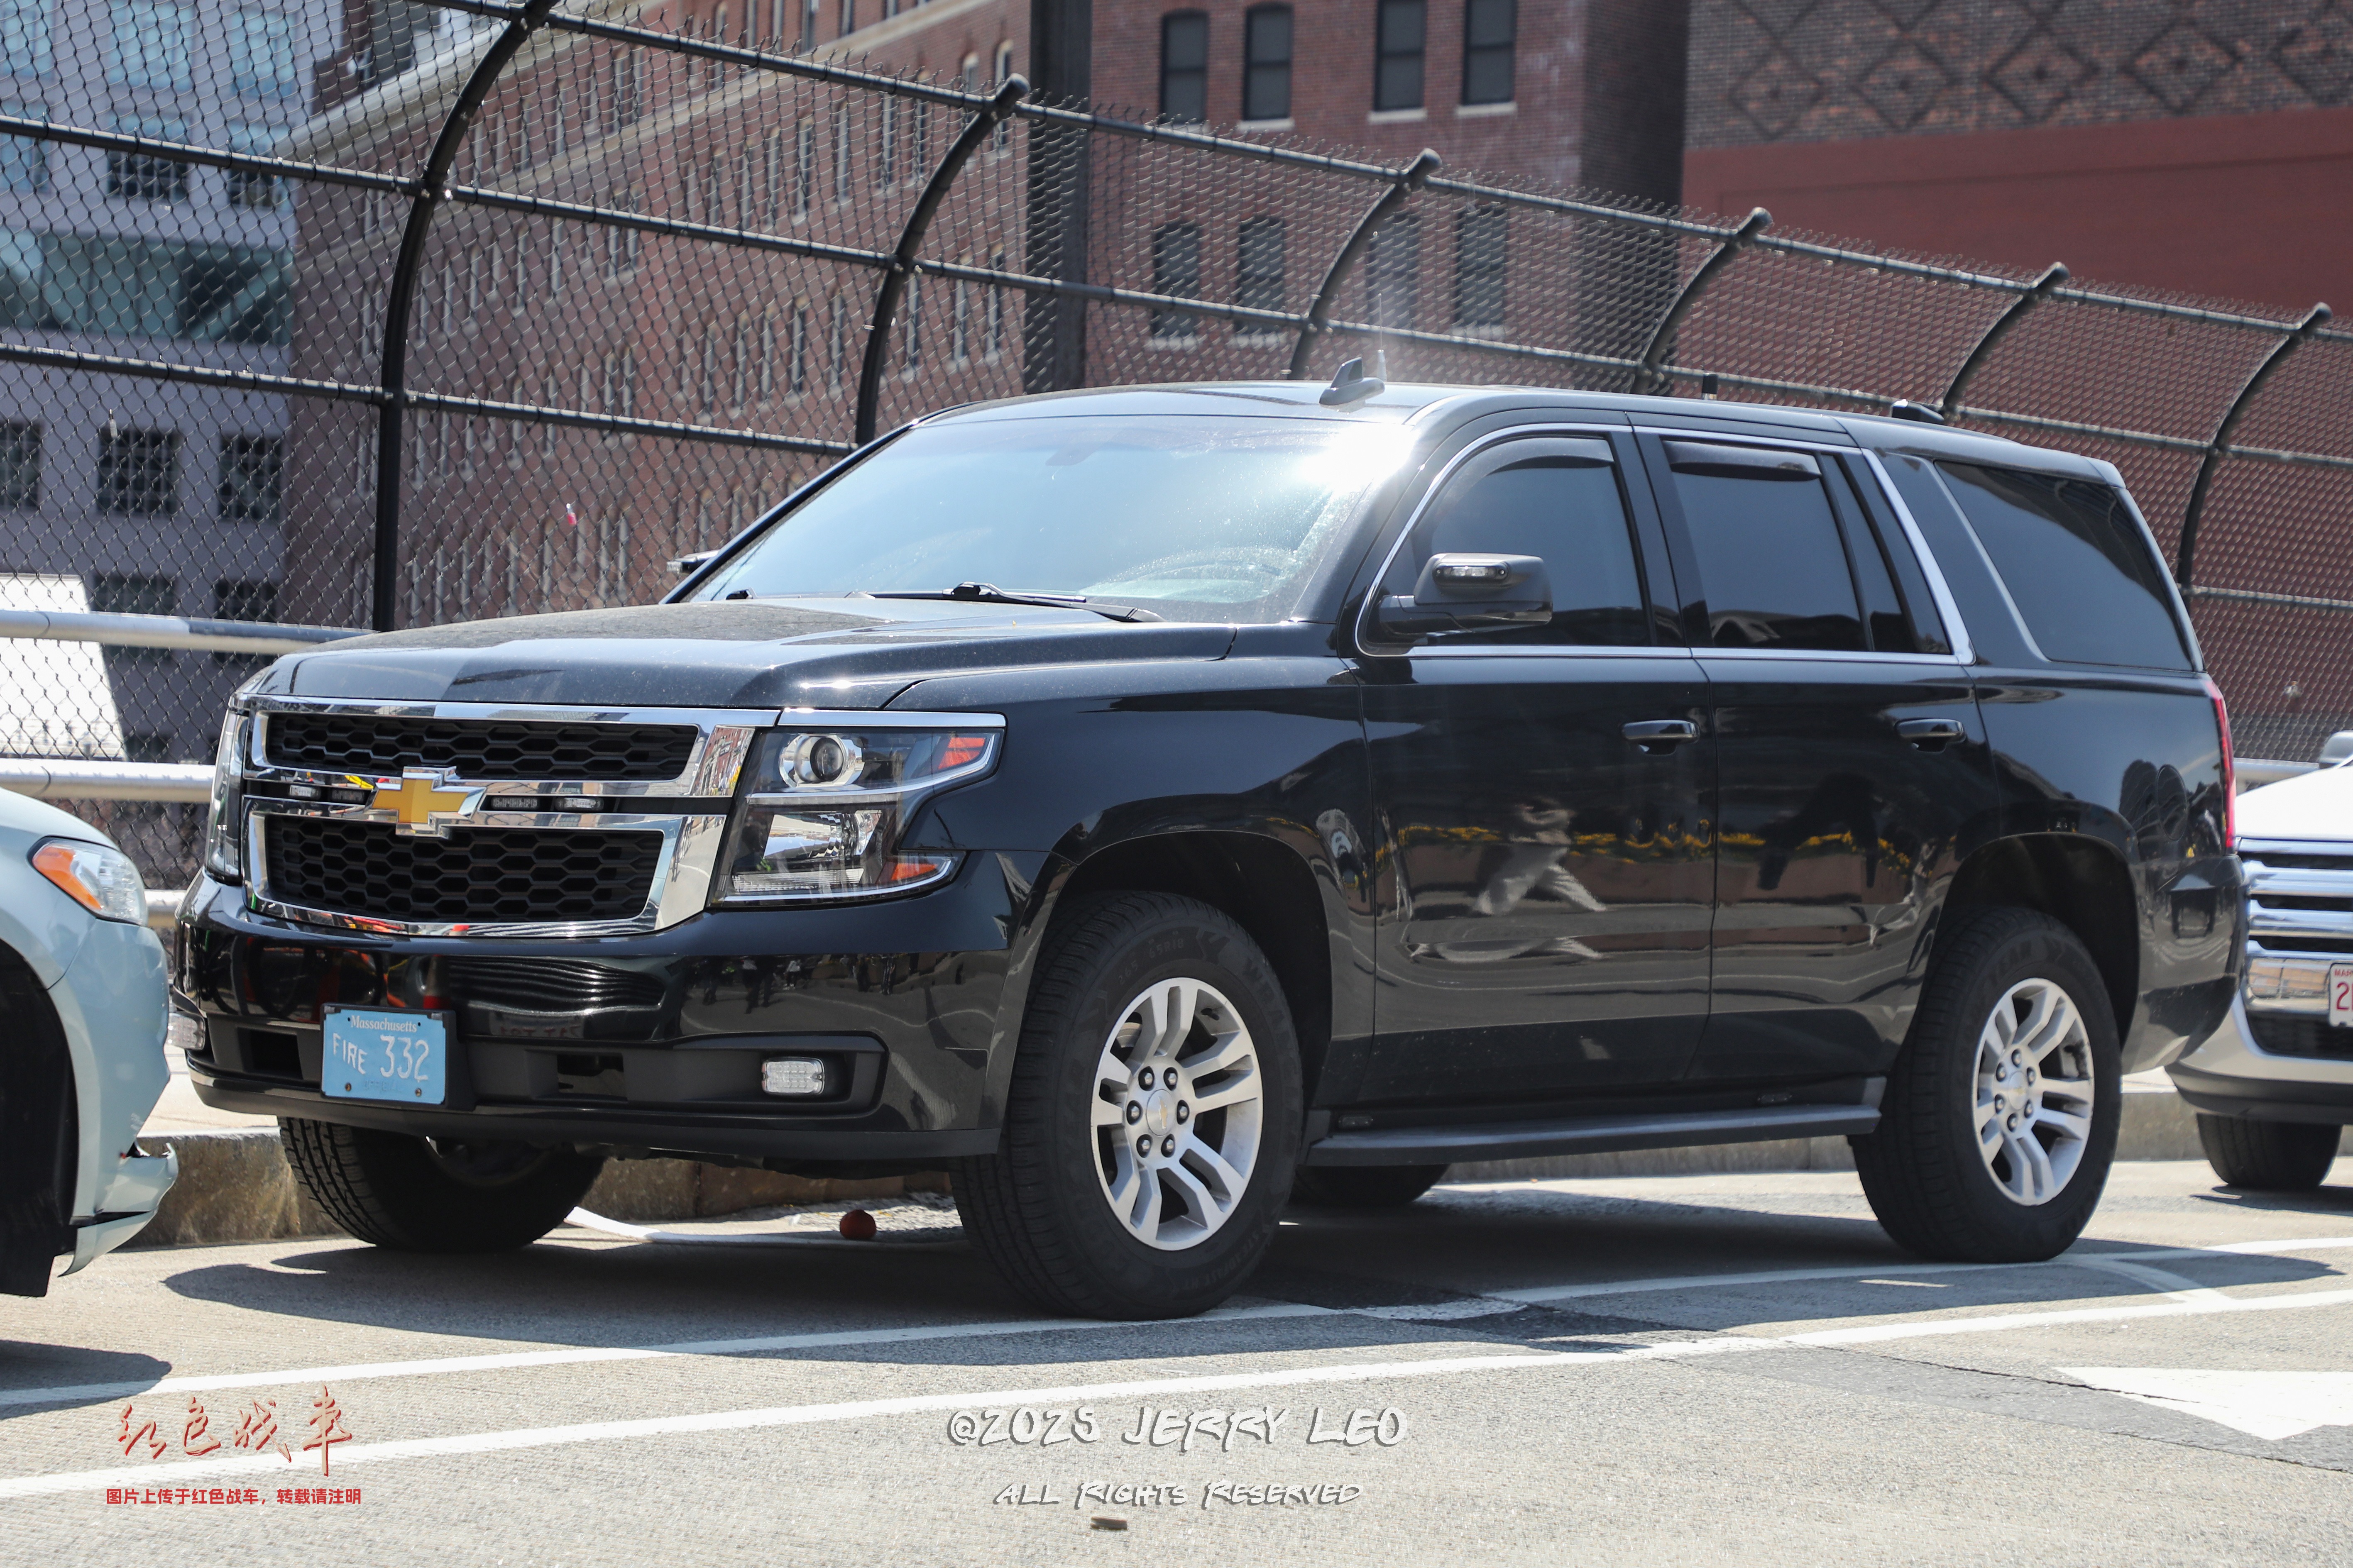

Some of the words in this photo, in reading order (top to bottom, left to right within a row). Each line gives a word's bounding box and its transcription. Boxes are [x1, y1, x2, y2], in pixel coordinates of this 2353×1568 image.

[351, 1015, 417, 1032] Massachusetts
[333, 1033, 367, 1075] FIRE
[380, 1035, 429, 1082] 332
